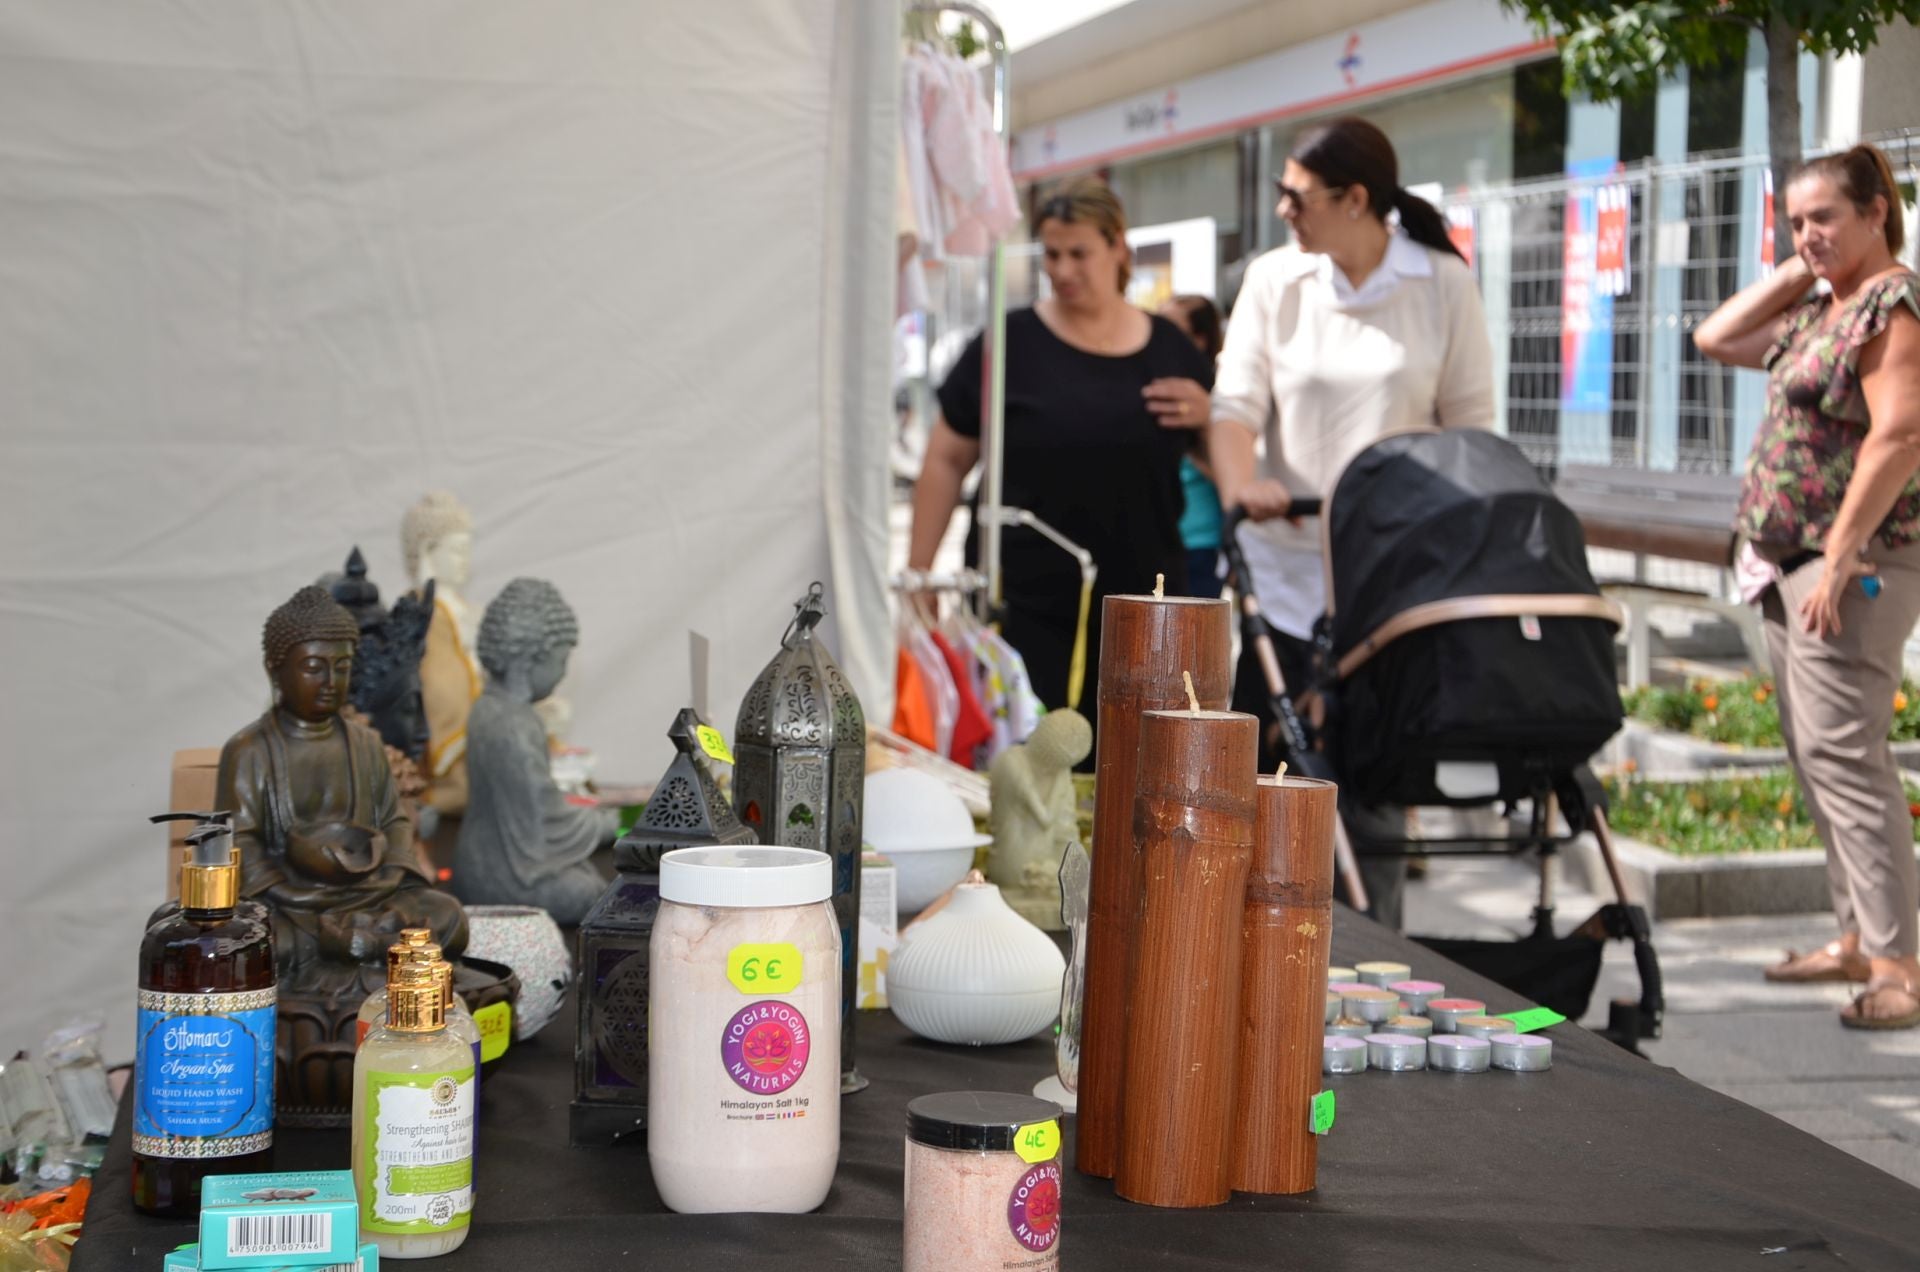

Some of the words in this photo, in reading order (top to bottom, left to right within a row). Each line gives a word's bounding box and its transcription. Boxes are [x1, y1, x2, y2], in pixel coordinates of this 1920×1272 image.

[742, 958, 781, 981] 6€
[164, 1021, 233, 1050] Ottoman
[161, 1059, 207, 1079] Argan
[207, 1059, 234, 1079] Spa
[732, 1058, 803, 1089] NATURALS
[151, 1086, 181, 1098] LIQUID
[184, 1087, 214, 1098] HAND
[216, 1087, 243, 1097] WASH
[721, 1100, 774, 1111] Himalayan
[776, 1099, 792, 1108] Salt
[795, 1098, 809, 1107] 1kg
[387, 1122, 450, 1139] Strengthening
[1025, 1130, 1045, 1148] 4€
[384, 1204, 416, 1214] 200ml
[239, 1244, 277, 1253] 750903
[281, 1242, 319, 1251] 007946
